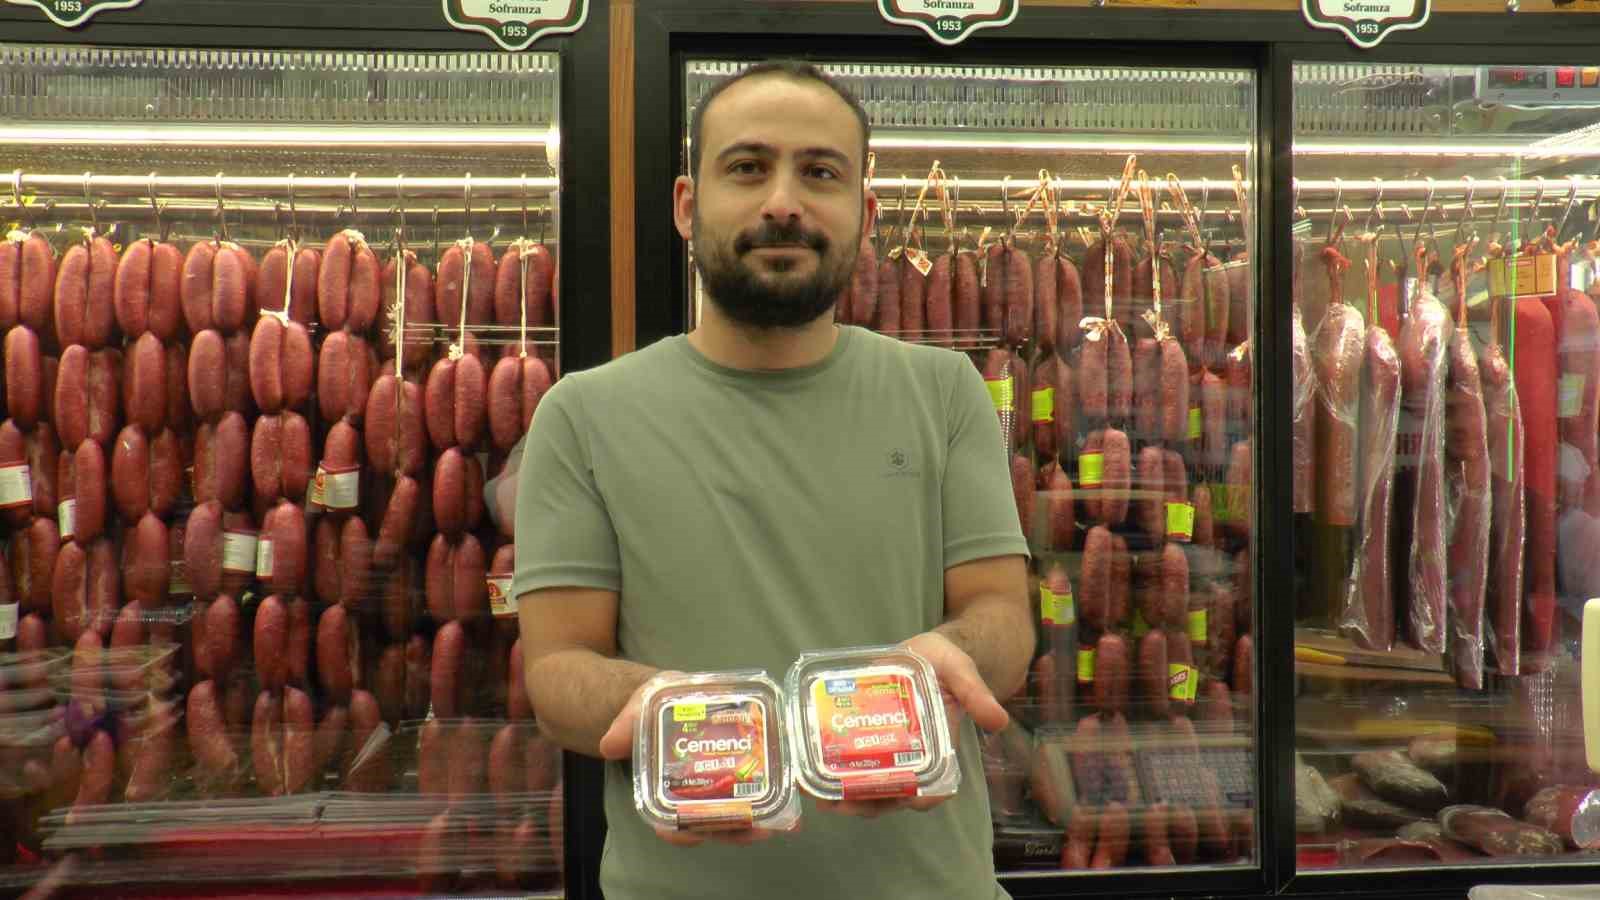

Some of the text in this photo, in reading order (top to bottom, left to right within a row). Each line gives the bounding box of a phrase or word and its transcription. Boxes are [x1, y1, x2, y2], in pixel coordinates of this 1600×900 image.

[54, 1, 82, 11] 1953
[501, 25, 528, 37] 1953
[936, 20, 961, 31] 1953
[1356, 23, 1379, 34] 1953
